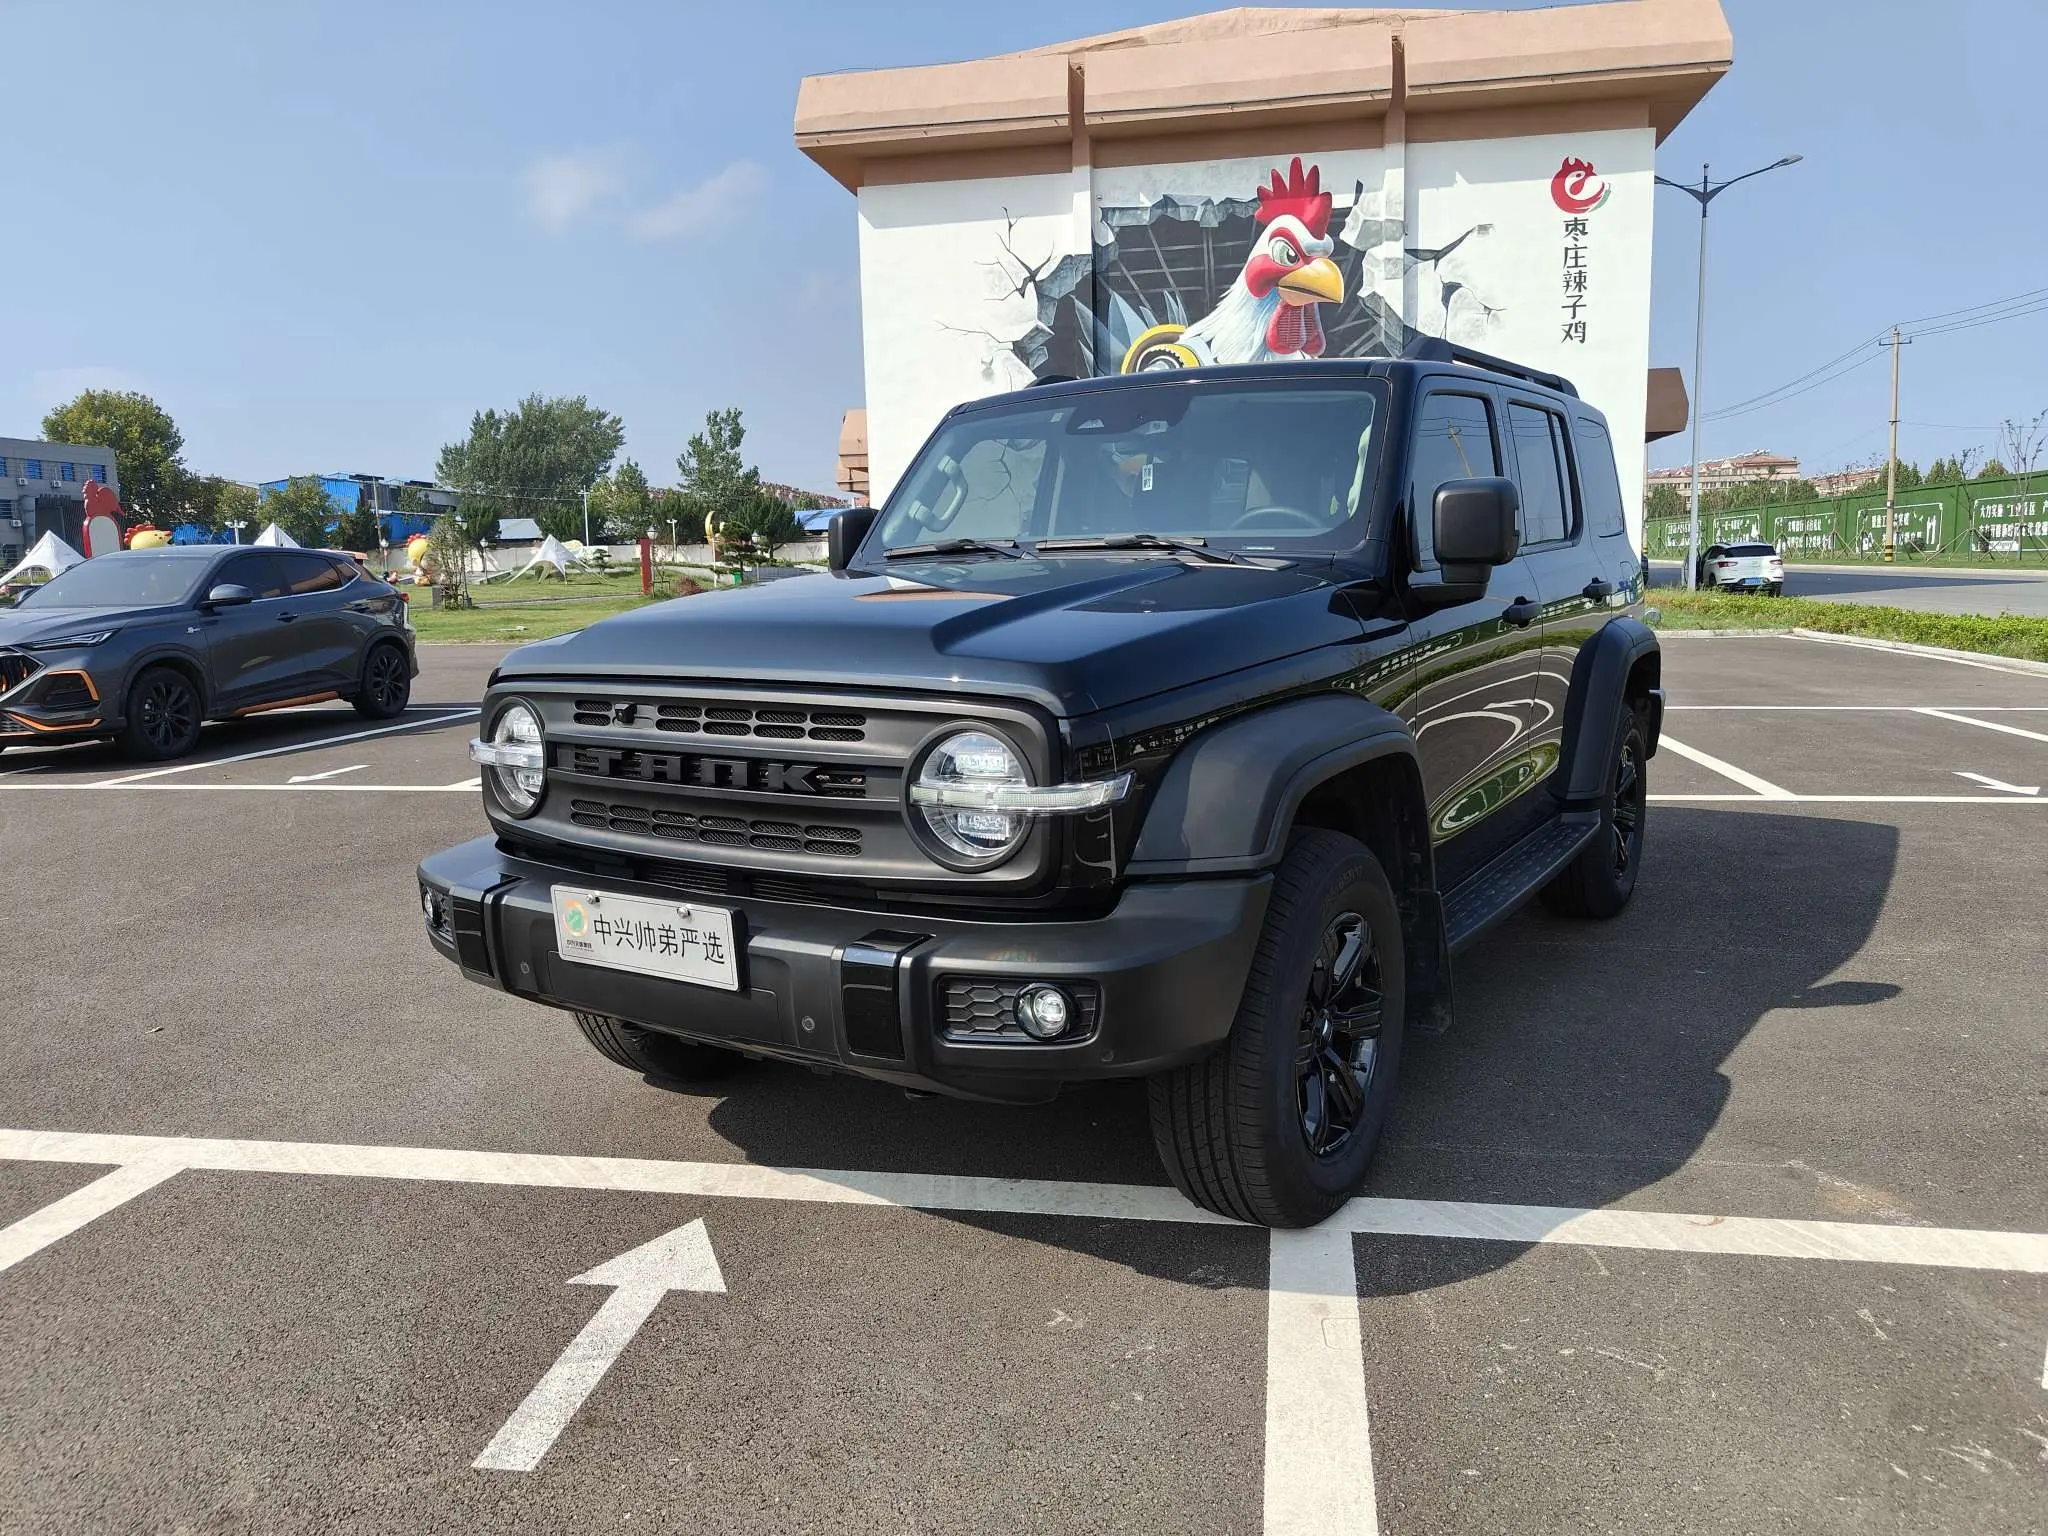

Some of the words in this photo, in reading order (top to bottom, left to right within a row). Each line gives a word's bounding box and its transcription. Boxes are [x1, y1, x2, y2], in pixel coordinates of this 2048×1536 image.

[1561, 216, 1588, 343] 枣庄辣子鸡
[586, 748, 824, 794] TANK
[593, 913, 725, 965] 中兴帅弟严选
